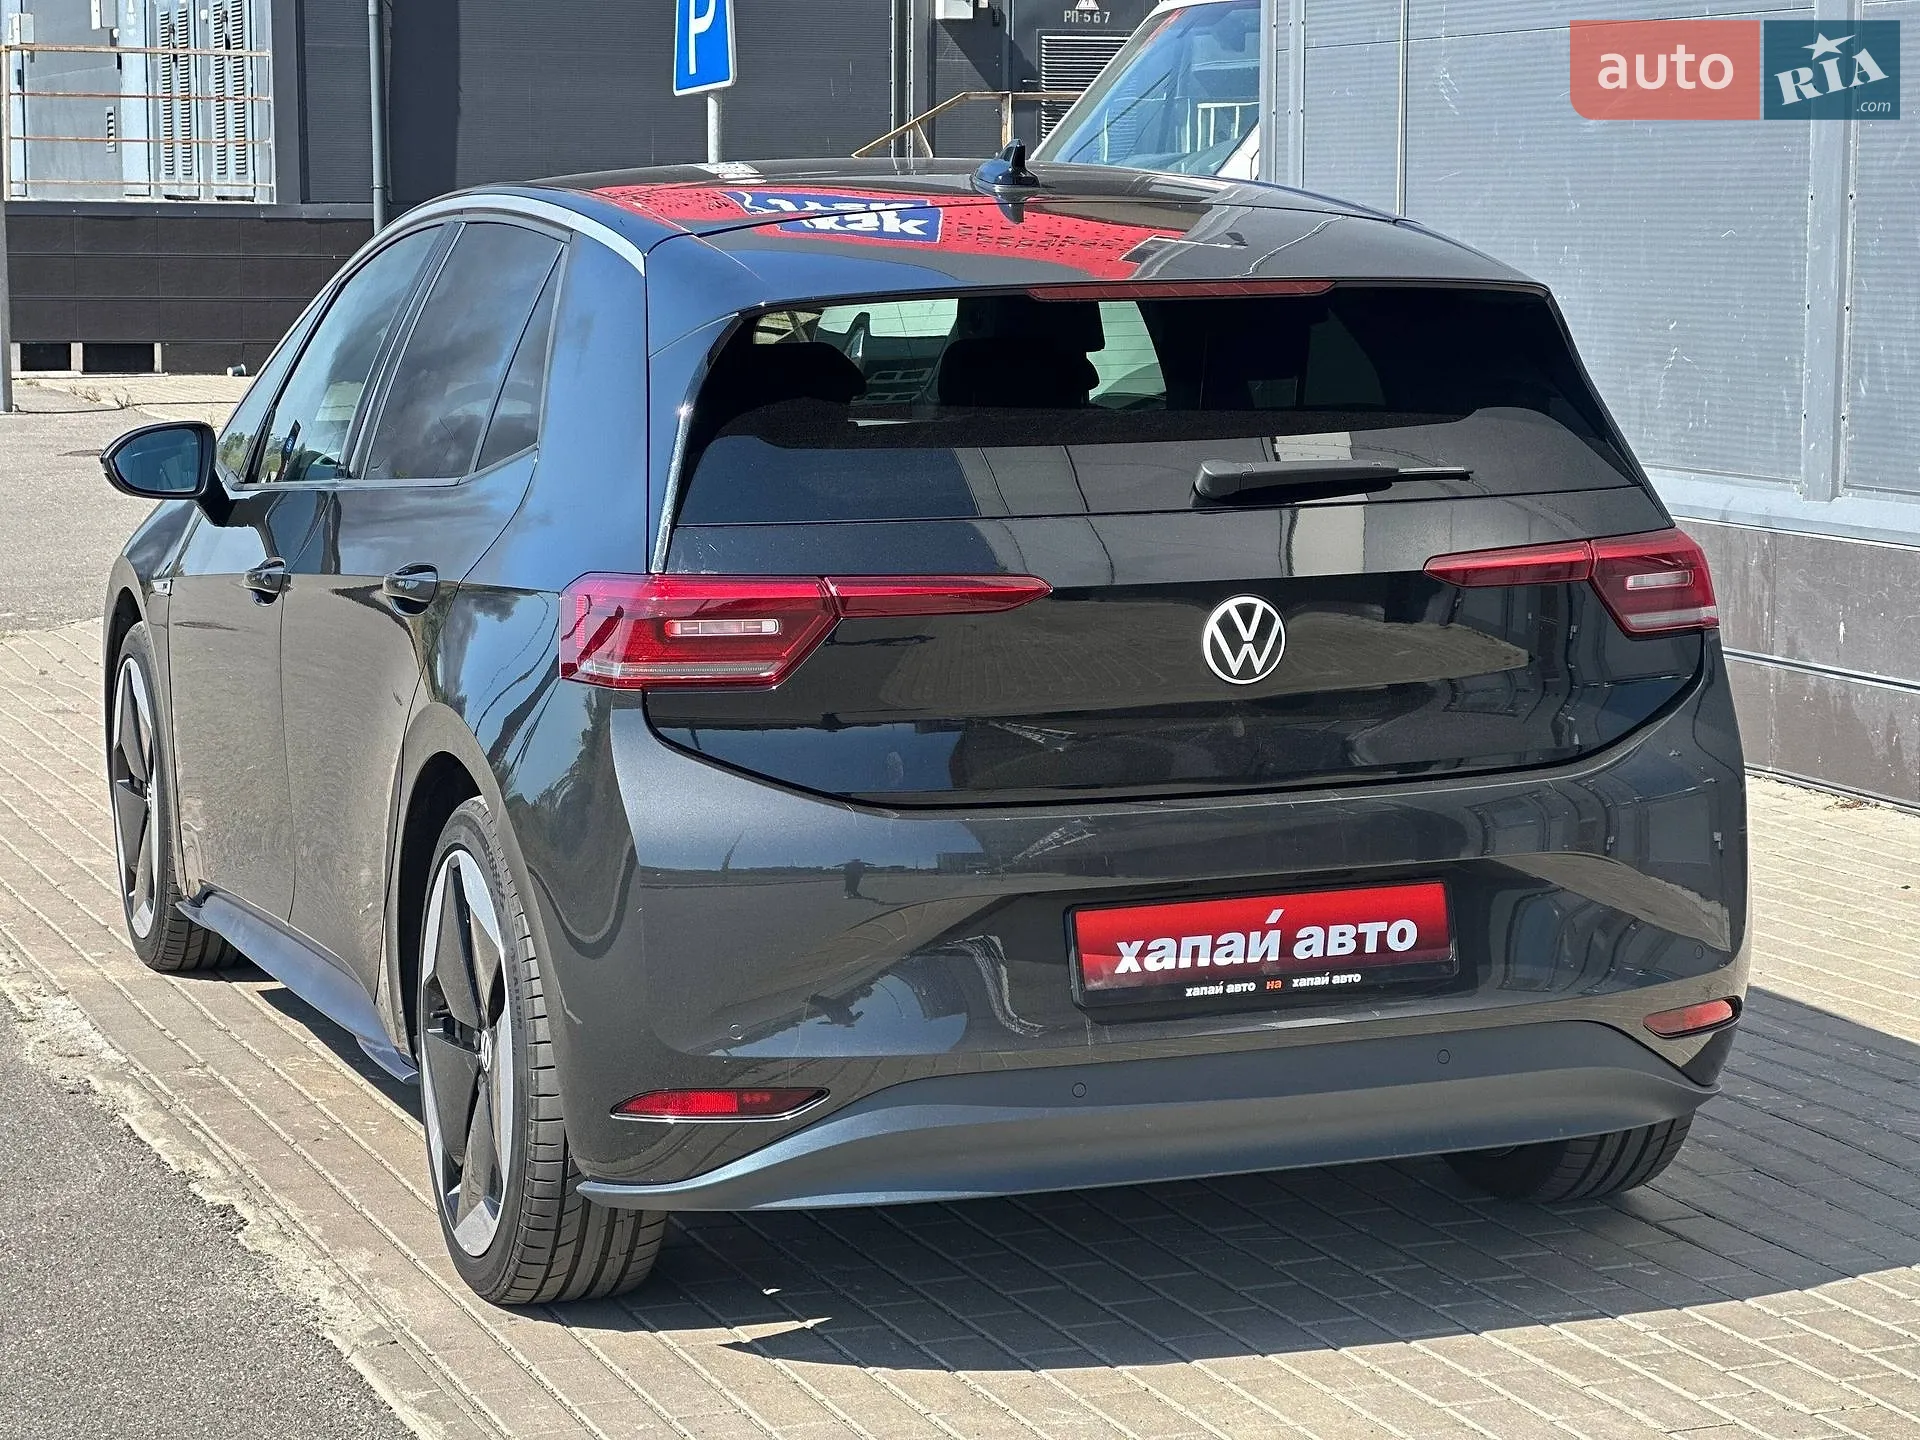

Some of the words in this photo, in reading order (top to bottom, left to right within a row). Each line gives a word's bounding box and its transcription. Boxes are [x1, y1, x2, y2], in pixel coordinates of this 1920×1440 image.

[689, 0, 717, 75] P
[1208, 599, 1282, 680] VW
[1293, 918, 1418, 960] авто
[1226, 982, 1257, 994] авто
[1266, 979, 1282, 990] на
[1332, 973, 1362, 984] авто
